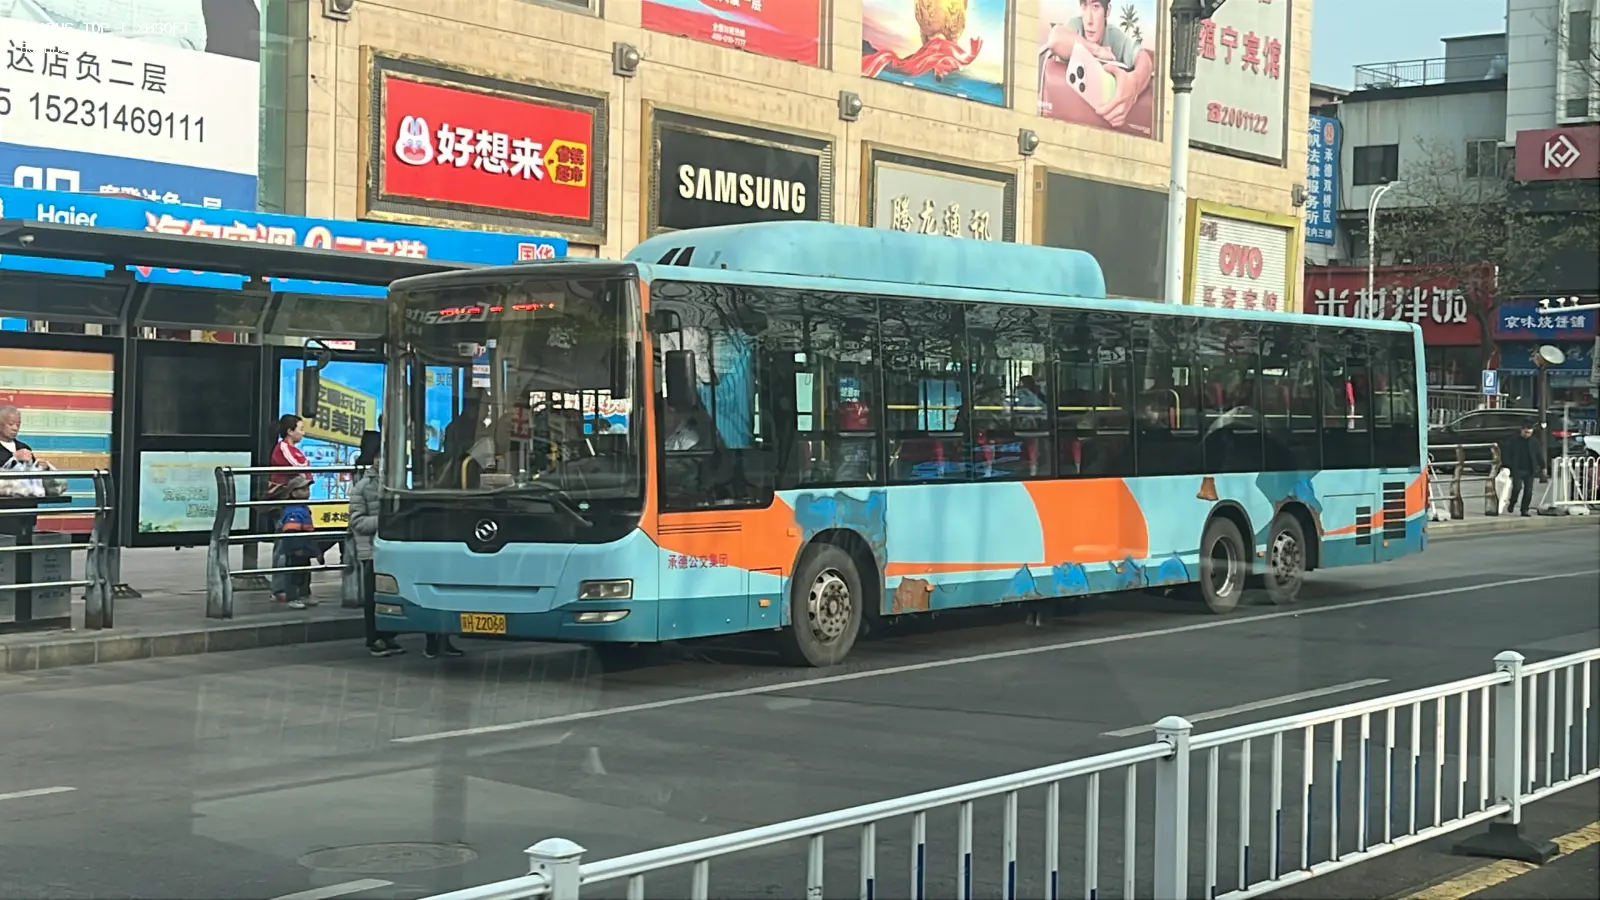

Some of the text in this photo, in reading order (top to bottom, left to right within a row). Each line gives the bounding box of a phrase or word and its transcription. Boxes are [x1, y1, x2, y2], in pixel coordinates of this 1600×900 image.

[29, 92, 205, 143] 15231469111
[437, 123, 545, 181] 好想来
[678, 164, 807, 214] SAMSUNG
[37, 203, 98, 227] Haier
[891, 195, 993, 242] 腾龙通讯
[1219, 242, 1263, 280] OYO
[1315, 286, 1468, 323] 米村拌饭
[668, 553, 729, 570] 承德公交集团
